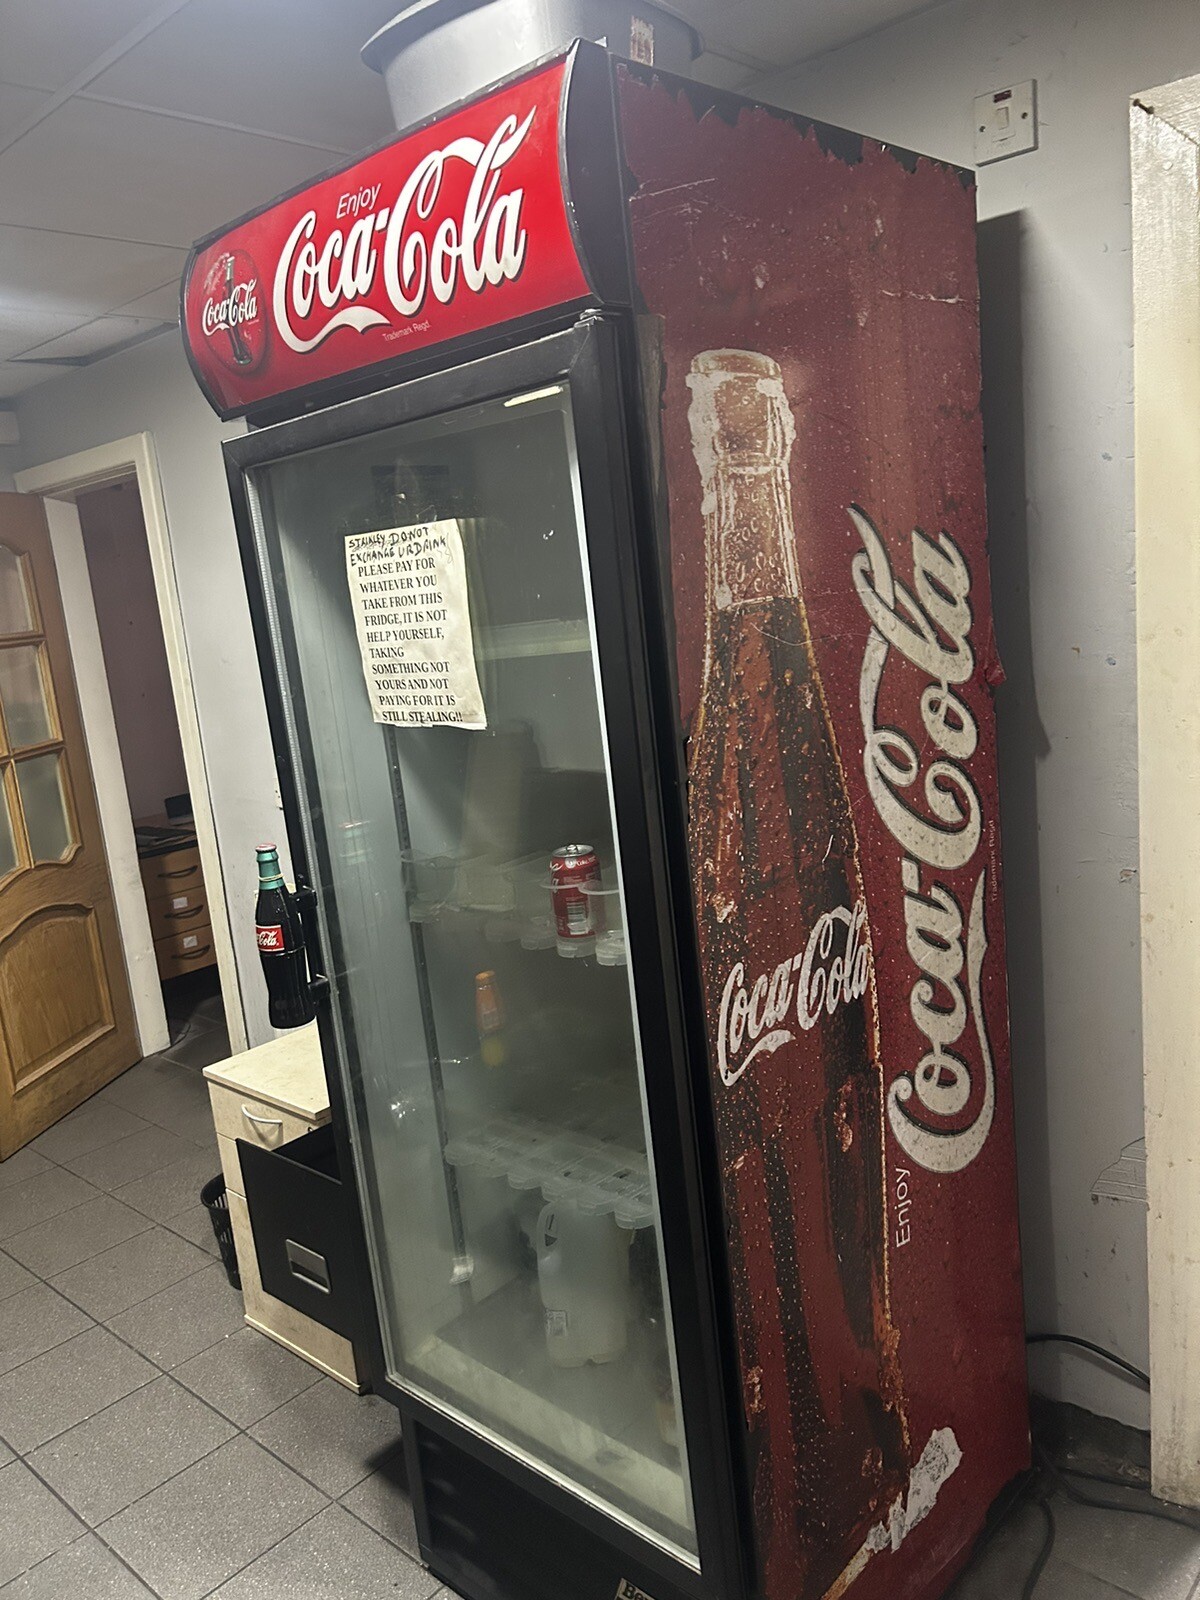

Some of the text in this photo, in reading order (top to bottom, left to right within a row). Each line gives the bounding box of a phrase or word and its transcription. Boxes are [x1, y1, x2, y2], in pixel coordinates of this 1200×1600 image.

[336, 183, 381, 220] Enjoy
[273, 105, 537, 353] Coca-Cola
[202, 278, 258, 336] Coca-Cola
[358, 557, 436, 577] PLEASE PAY FOR
[360, 574, 437, 593] WHATEVER YOU
[362, 592, 443, 610] TAKE FROM THIS
[364, 609, 447, 627] FRIDGE, IT IS NOT
[366, 627, 445, 643] HELP YOURSELF,
[369, 647, 404, 659] TAKING
[371, 661, 449, 675] SOMETHING NOT
[375, 678, 449, 690] YOURS AND NOT
[379, 694, 456, 706] PAYING FOR IT IS
[382, 711, 463, 724] STILL STEALING!!
[846, 503, 995, 1174] Coca-Cola
[717, 899, 874, 1087] Coca-Cola
[895, 1167, 912, 1247] Enjoy
